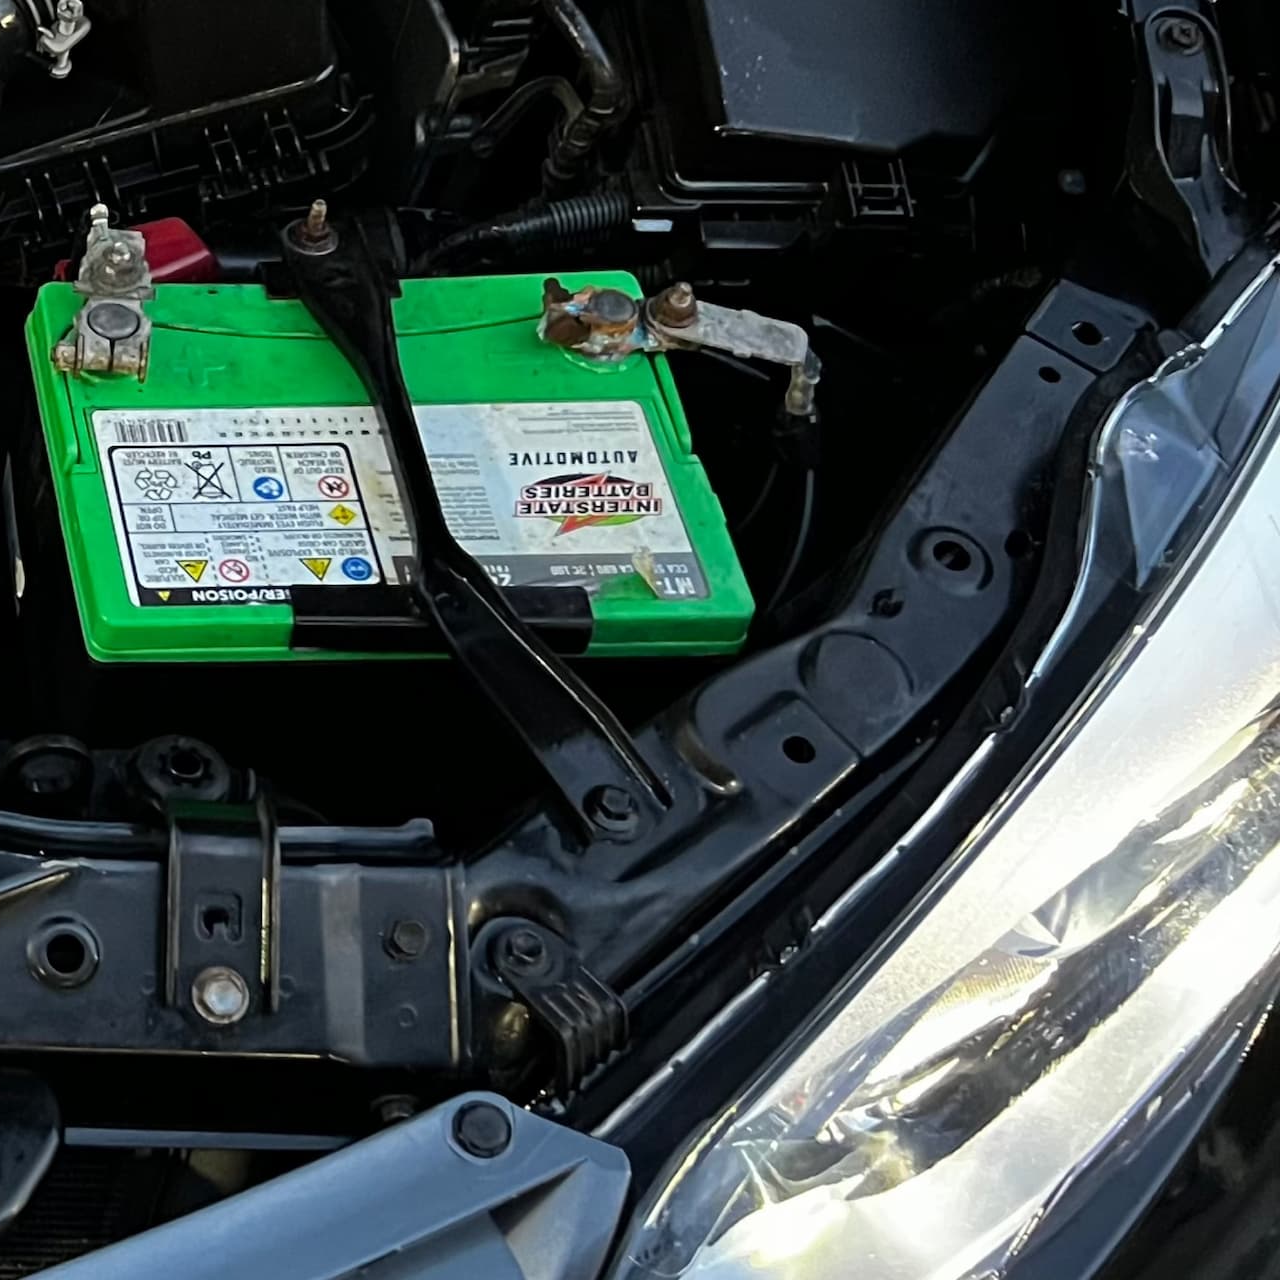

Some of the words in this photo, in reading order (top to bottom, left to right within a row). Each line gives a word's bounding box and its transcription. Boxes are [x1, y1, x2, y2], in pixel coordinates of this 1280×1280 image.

[192, 451, 212, 460] Pb
[507, 450, 638, 467] AUTOMOTIVE
[523, 484, 650, 499] BATTERIES
[518, 499, 660, 516] INTERSTATE
[191, 588, 290, 602] ER/POISON
